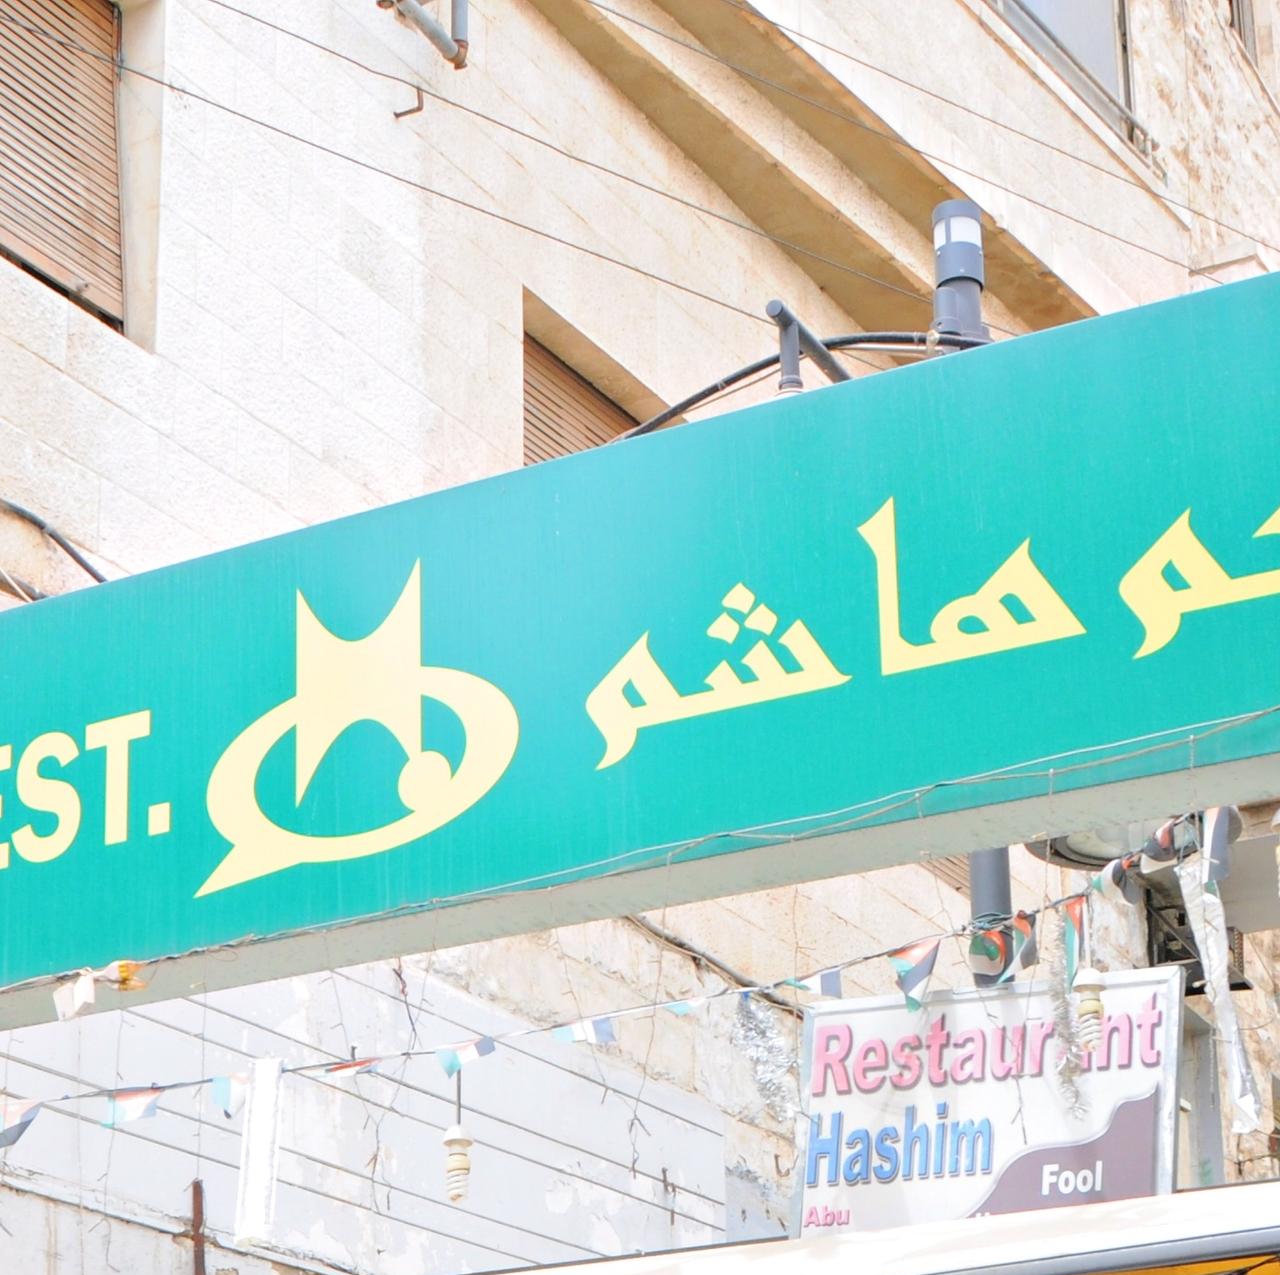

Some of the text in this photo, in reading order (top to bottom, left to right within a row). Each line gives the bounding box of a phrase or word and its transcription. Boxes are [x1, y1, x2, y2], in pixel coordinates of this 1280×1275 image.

[585, 496, 1086, 770] هاشم
[806, 1102, 992, 1186] Hashim
[1041, 1161, 1103, 1196] Fool
[804, 1205, 850, 1229] Abu
